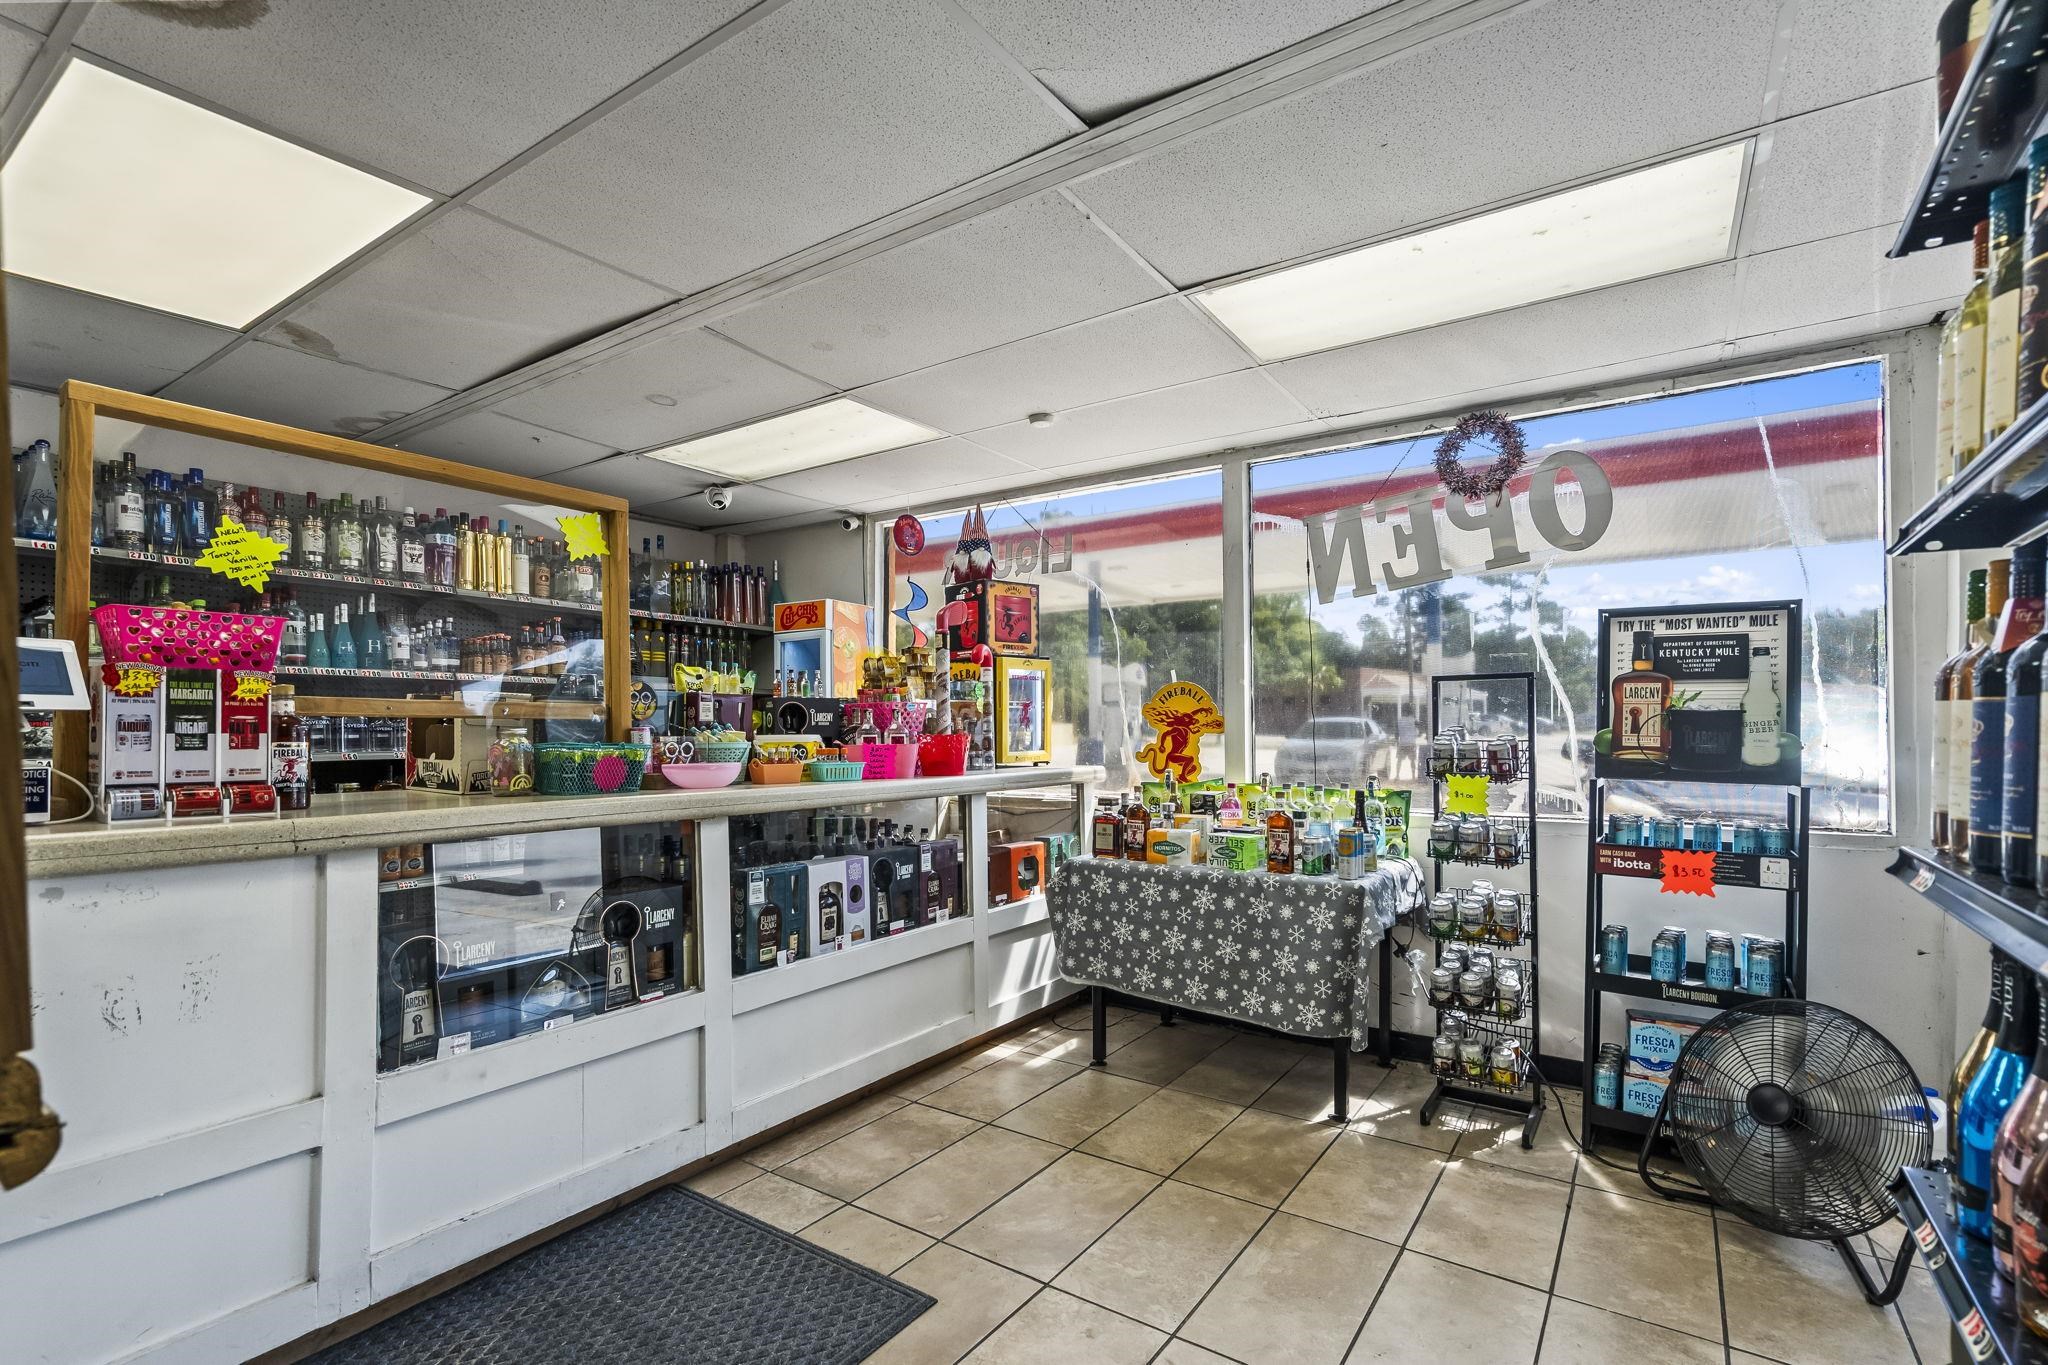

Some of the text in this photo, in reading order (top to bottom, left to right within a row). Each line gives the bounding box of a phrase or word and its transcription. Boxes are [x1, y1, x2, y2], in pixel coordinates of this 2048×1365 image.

[130, 552, 156, 560] 2700
[165, 556, 190, 565] 1800
[227, 556, 259, 565] Vanilla
[1617, 620, 1635, 632] TRY
[1638, 619, 1656, 631] THE
[1750, 614, 1779, 627] MULE
[1660, 648, 1740, 657] KENTUCKY MULE
[286, 666, 308, 674] 1200
[336, 668, 358, 676] 1475
[124, 683, 152, 691] SALE
[170, 688, 214, 700] MARGARITA
[1159, 687, 1205, 705] FIREBALL
[1624, 687, 1660, 699] LARCENY
[815, 713, 833, 722] LARCENY
[1744, 720, 1780, 728] GINGER
[22, 770, 47, 779] OTICE
[1209, 858, 1245, 870] TEQUILA
[1614, 858, 1651, 870] ibotta
[650, 908, 675, 924] LARCENY
[462, 941, 496, 960] LARCENY
[1991, 962, 2003, 1004] JADE
[1666, 988, 1690, 998] LARCENY
[406, 993, 431, 1010] ARCENY
[2003, 976, 2014, 1022] JADE
[1635, 1034, 1675, 1050] FRESCA
[1644, 1046, 1668, 1054] MIXED
[1628, 1090, 1661, 1105] FRESC
[1636, 1102, 1659, 1110] MIXE
